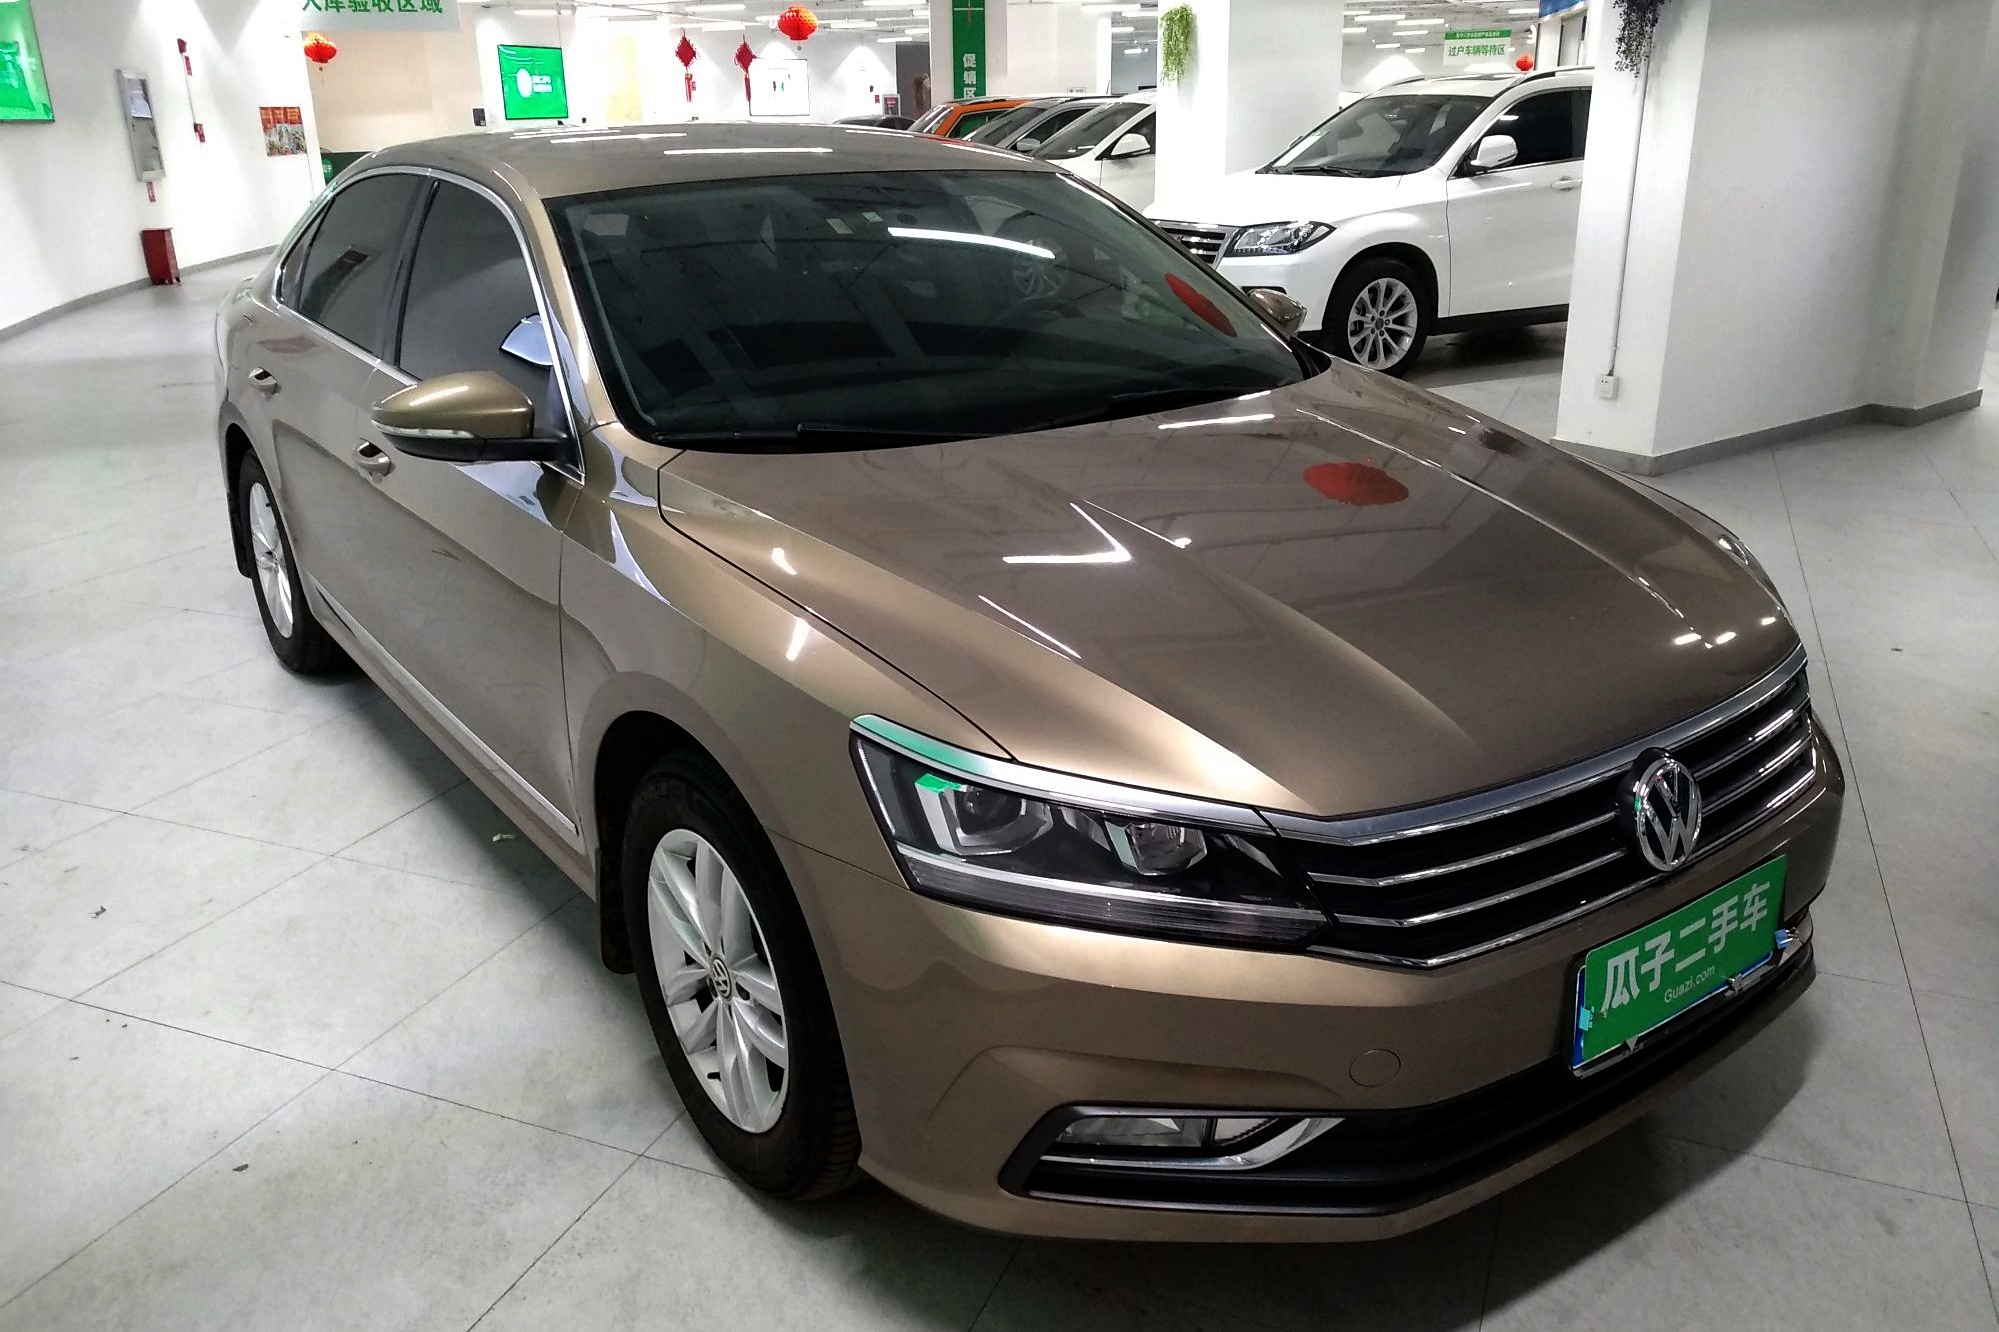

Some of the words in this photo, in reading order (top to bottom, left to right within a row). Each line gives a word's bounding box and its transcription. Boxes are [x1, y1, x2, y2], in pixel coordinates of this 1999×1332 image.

[963, 53, 977, 100] 促销区
[1600, 881, 1771, 1018] 瓜子二手车
[1664, 965, 1716, 1004] Guazi.com
